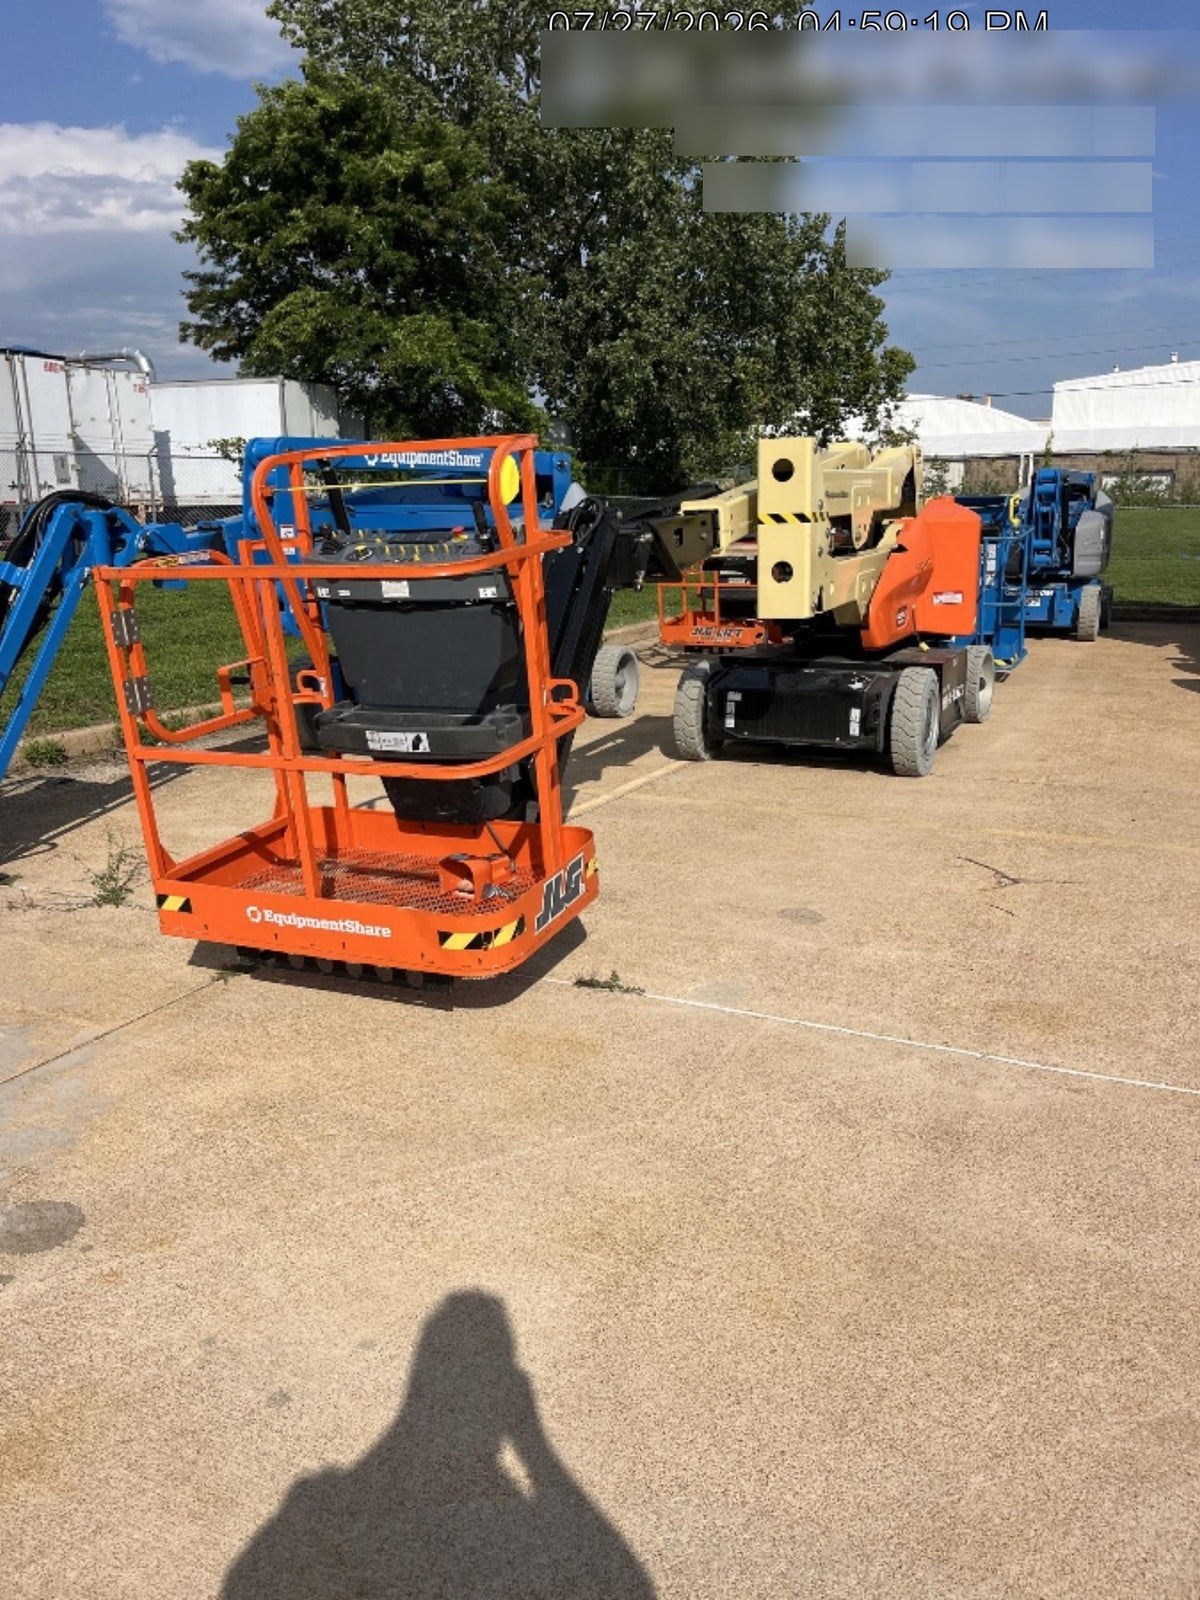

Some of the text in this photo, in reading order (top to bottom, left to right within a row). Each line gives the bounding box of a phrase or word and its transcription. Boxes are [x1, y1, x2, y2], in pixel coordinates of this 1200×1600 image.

[381, 450, 481, 468] EquipmentShare
[535, 853, 583, 935] JLG
[263, 909, 391, 938] EquipmentShare
